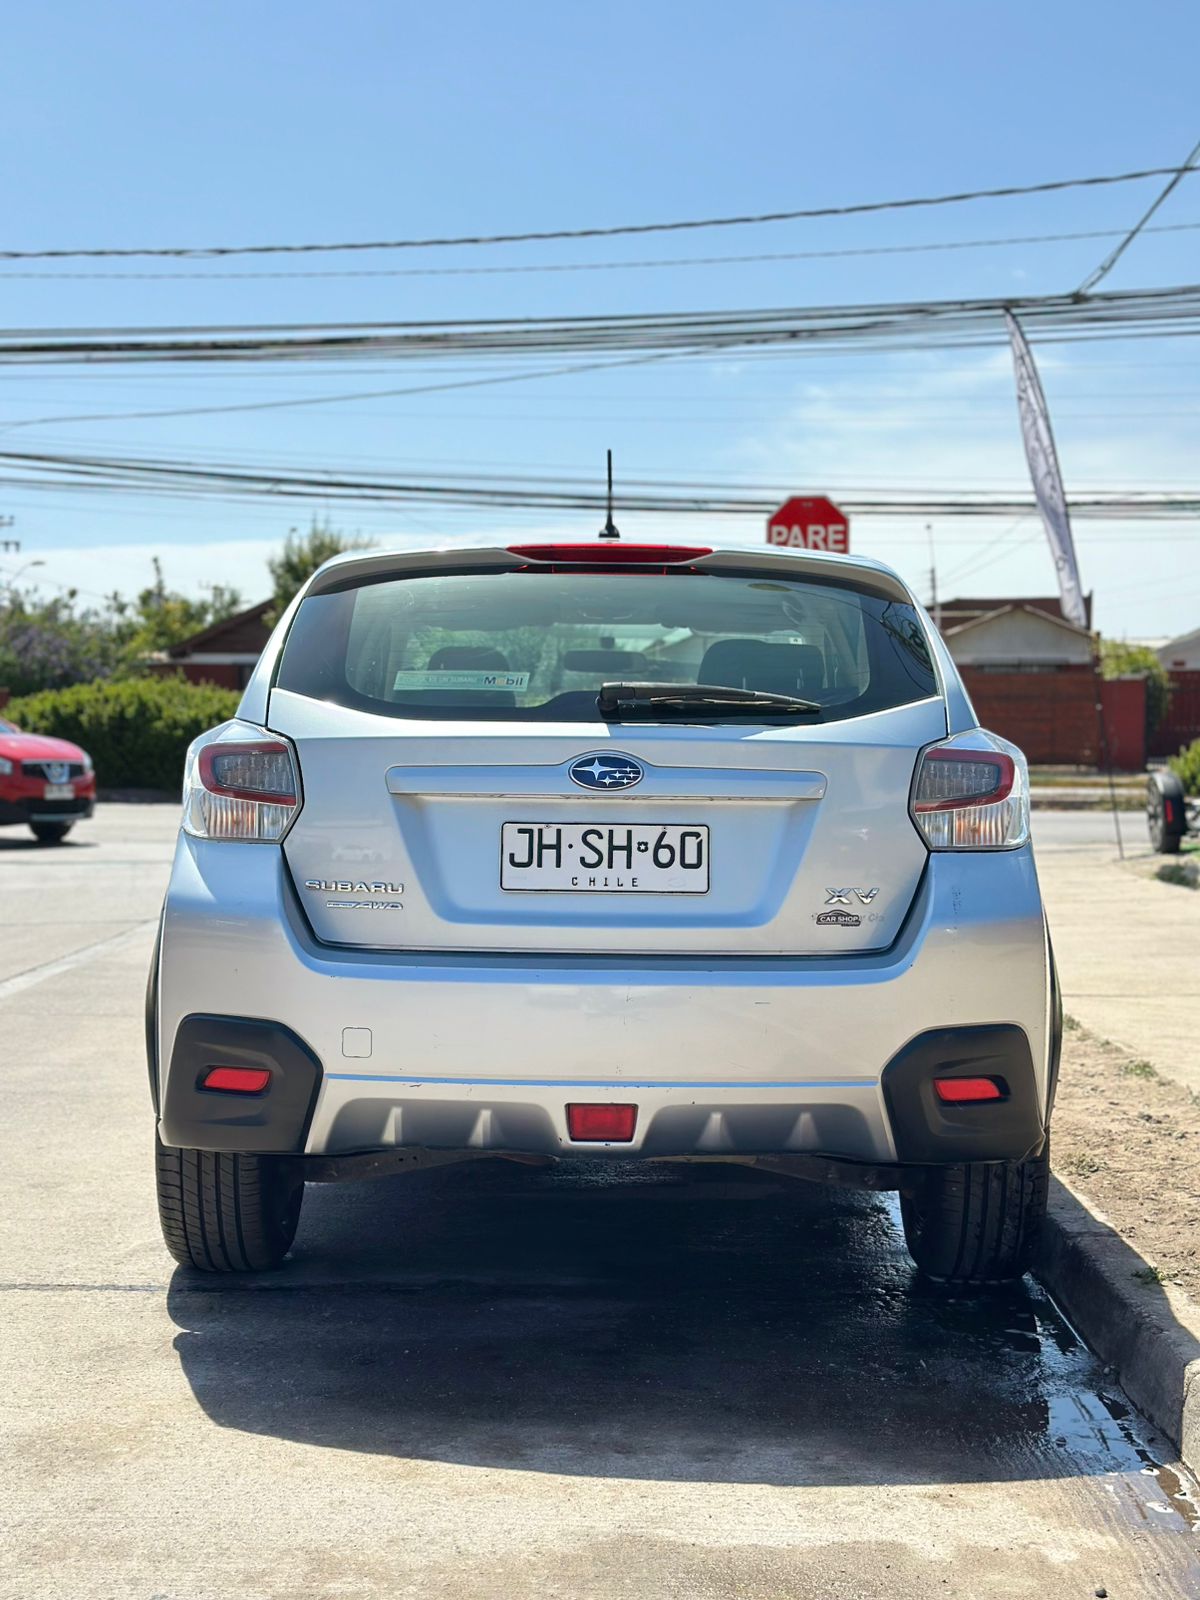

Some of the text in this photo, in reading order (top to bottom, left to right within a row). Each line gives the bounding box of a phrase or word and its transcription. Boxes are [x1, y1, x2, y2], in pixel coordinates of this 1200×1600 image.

[771, 524, 845, 550] PARE
[305, 880, 404, 894] SUBARU
[571, 877, 638, 888] CHILE
[824, 887, 880, 904] XV
[356, 901, 403, 910] AWD
